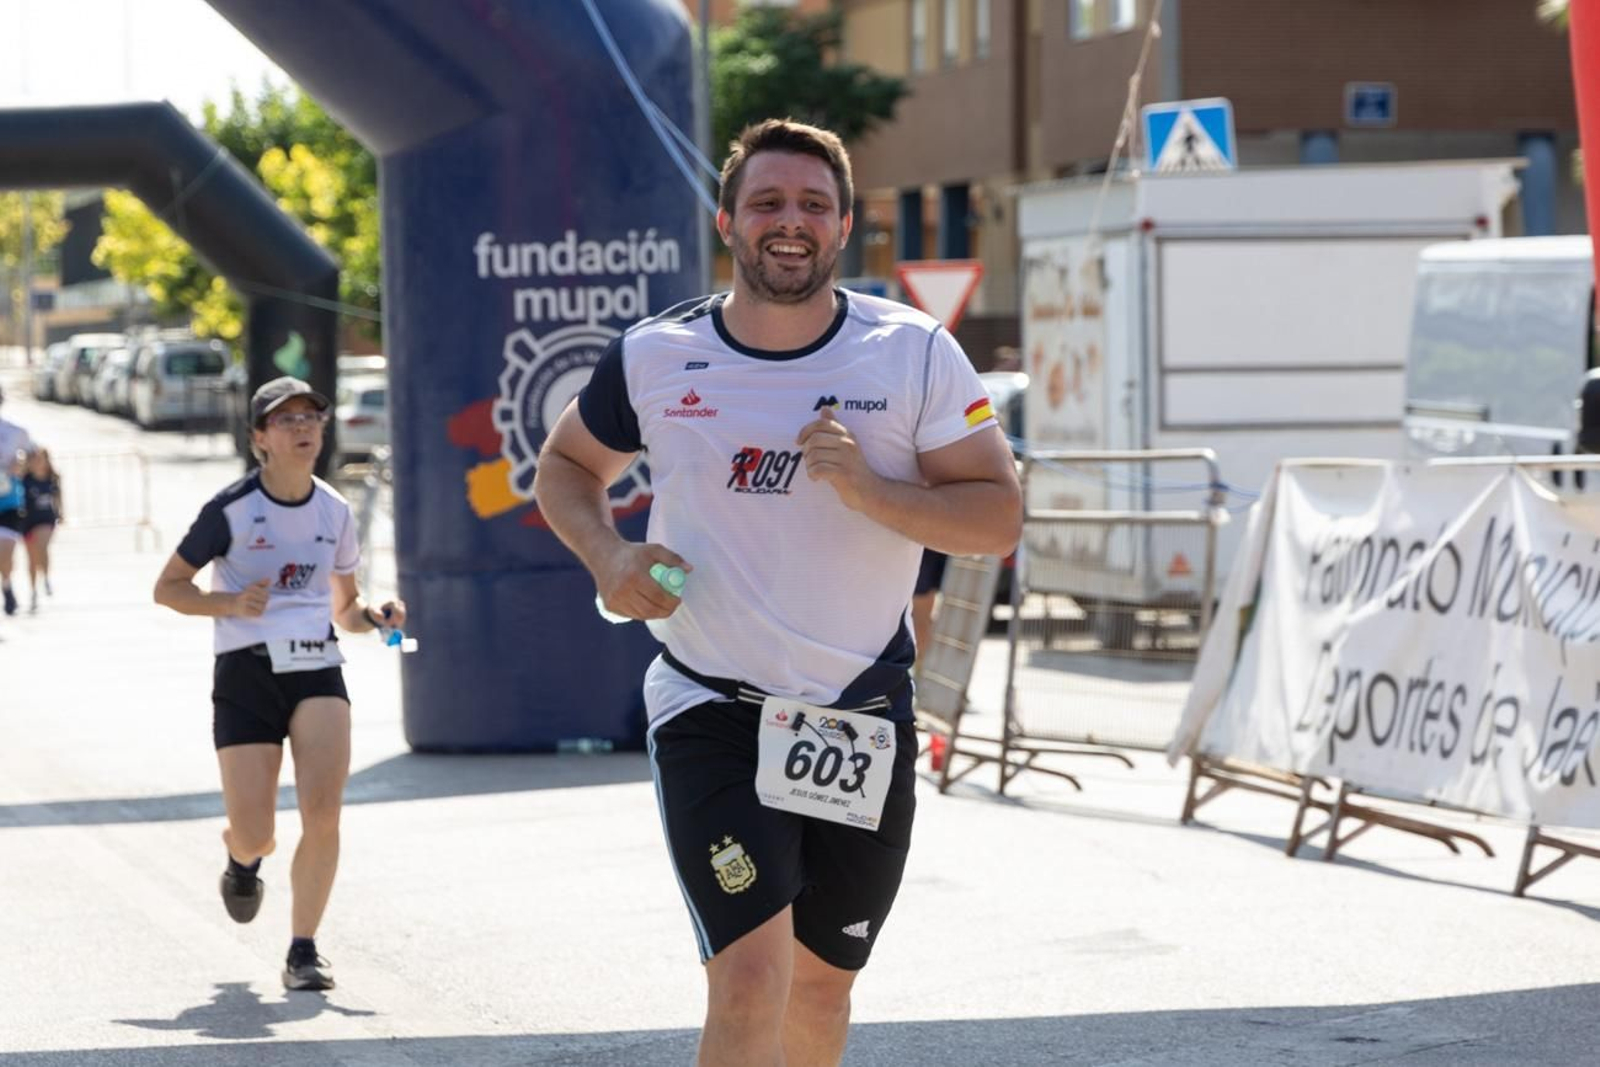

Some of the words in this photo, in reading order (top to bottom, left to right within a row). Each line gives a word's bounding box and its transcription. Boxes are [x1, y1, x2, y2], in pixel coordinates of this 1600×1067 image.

[473, 228, 680, 279] fundación
[513, 274, 649, 328] mupol
[662, 406, 719, 418] Santander
[844, 398, 887, 413] mupol
[784, 740, 872, 793] 603
